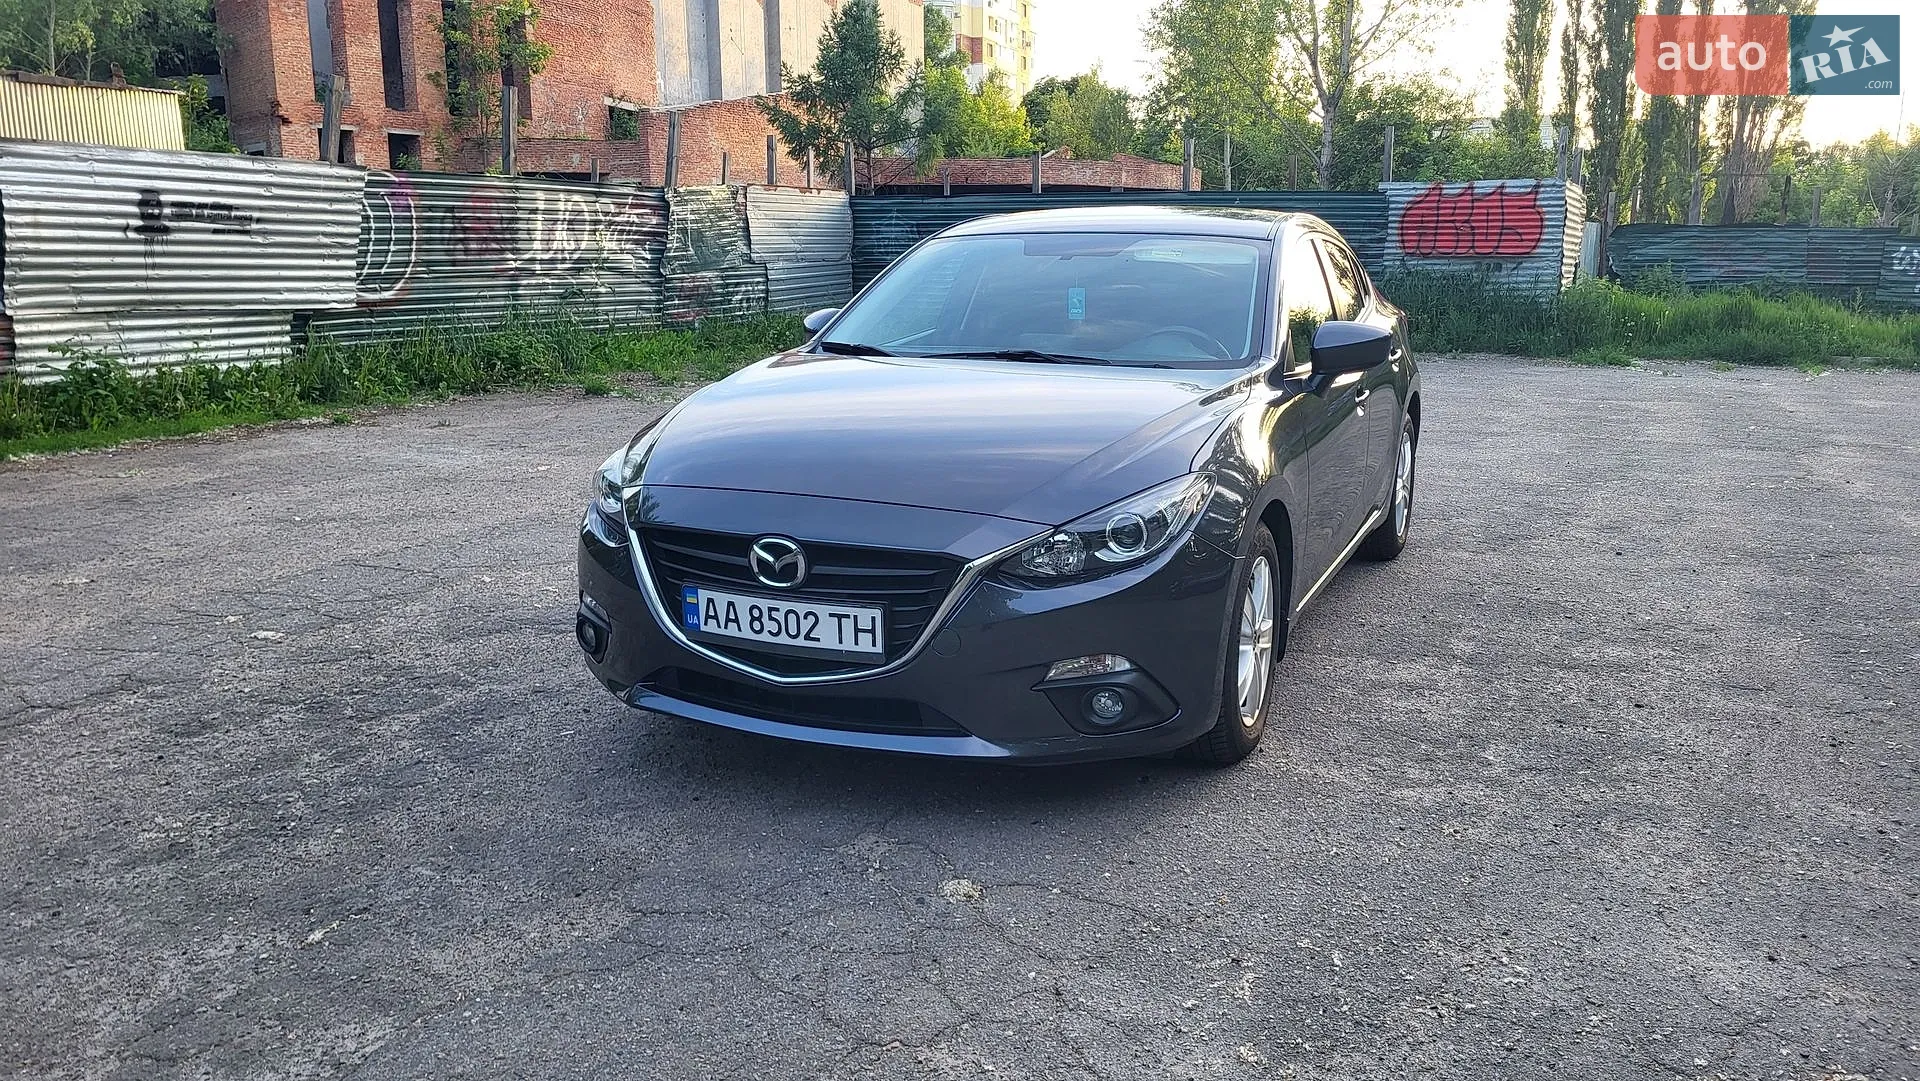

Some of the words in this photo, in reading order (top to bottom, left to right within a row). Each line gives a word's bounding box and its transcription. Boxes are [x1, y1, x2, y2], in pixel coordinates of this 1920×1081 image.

[687, 614, 699, 625] UA
[703, 597, 743, 633] AA
[748, 604, 821, 643] 8502
[828, 612, 877, 648] TH
